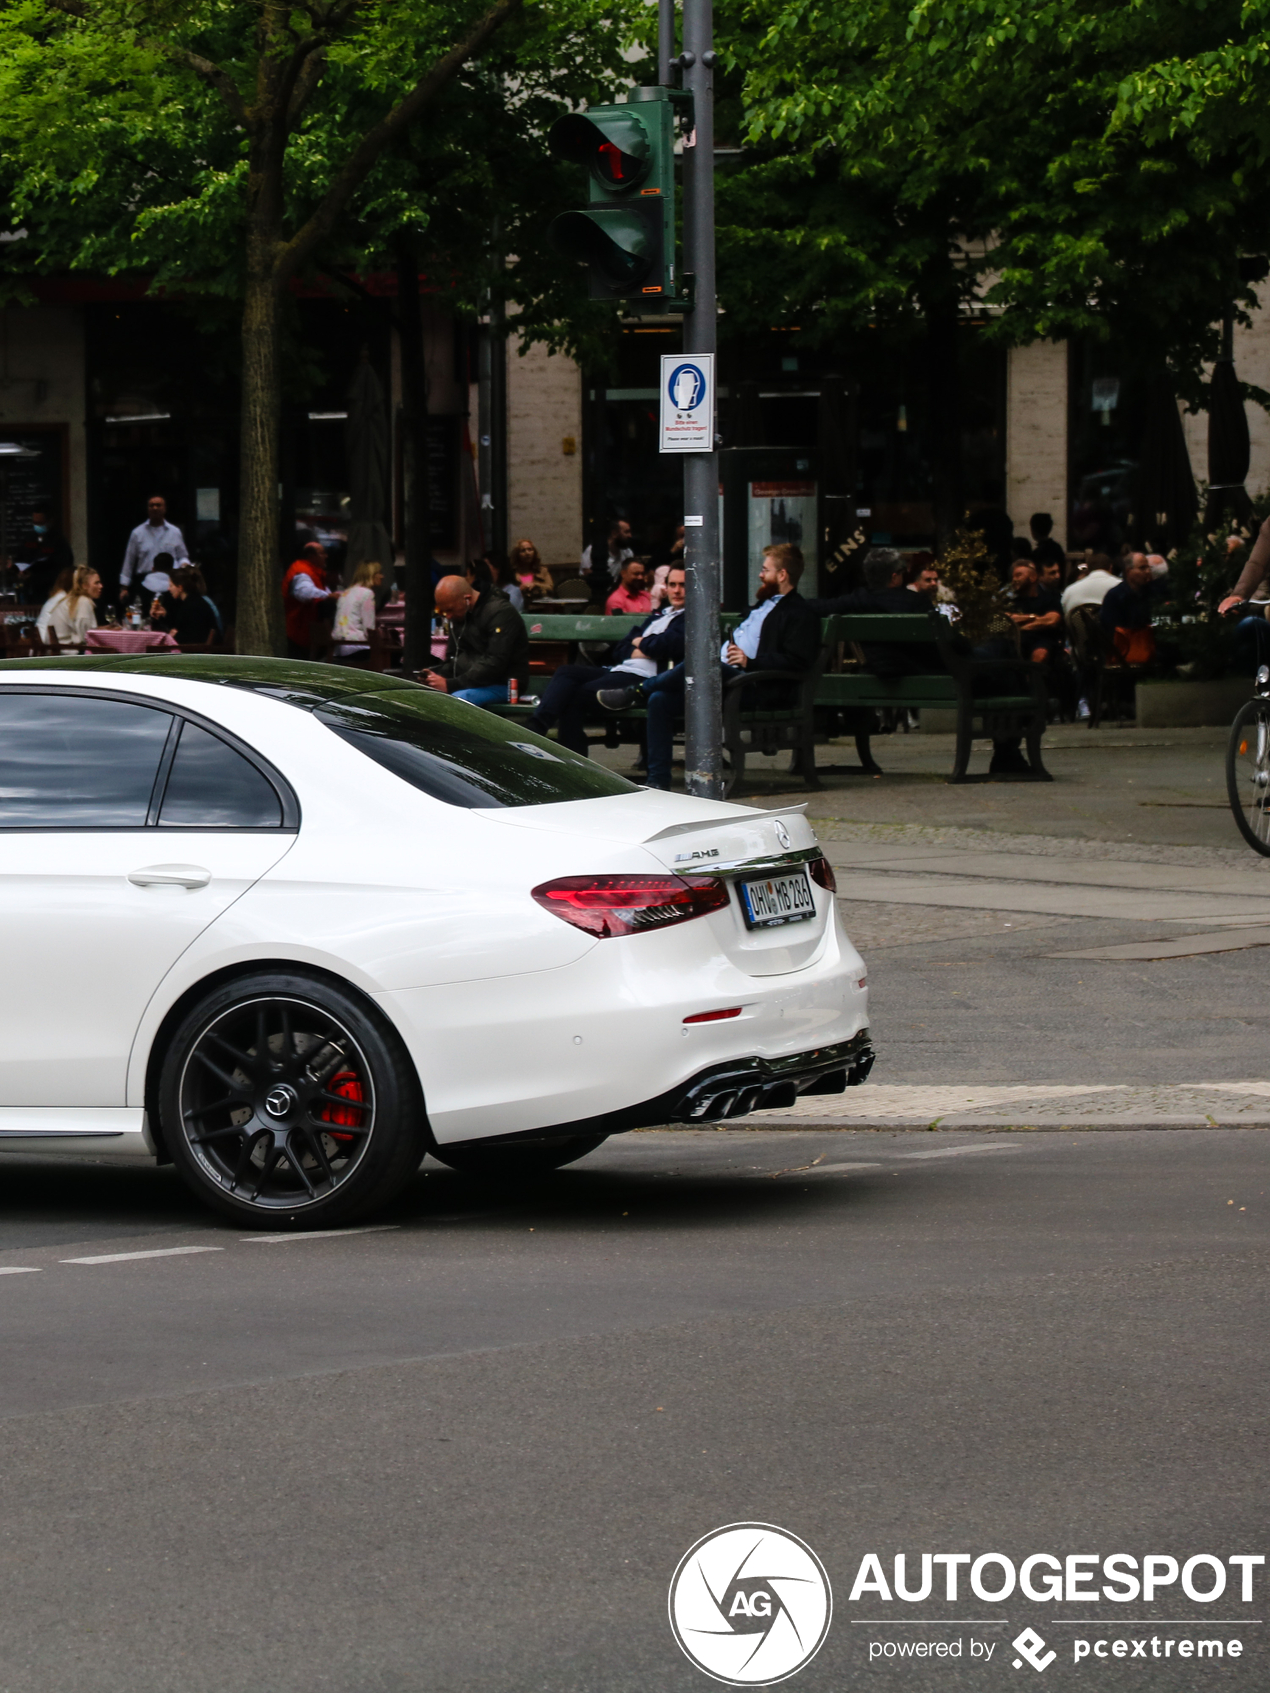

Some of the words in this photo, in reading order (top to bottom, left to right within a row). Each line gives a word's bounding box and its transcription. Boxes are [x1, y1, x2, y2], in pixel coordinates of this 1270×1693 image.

[691, 848, 720, 859] AMG
[750, 884, 772, 916] OHV
[774, 881, 791, 912] MB
[789, 878, 810, 909] 286
